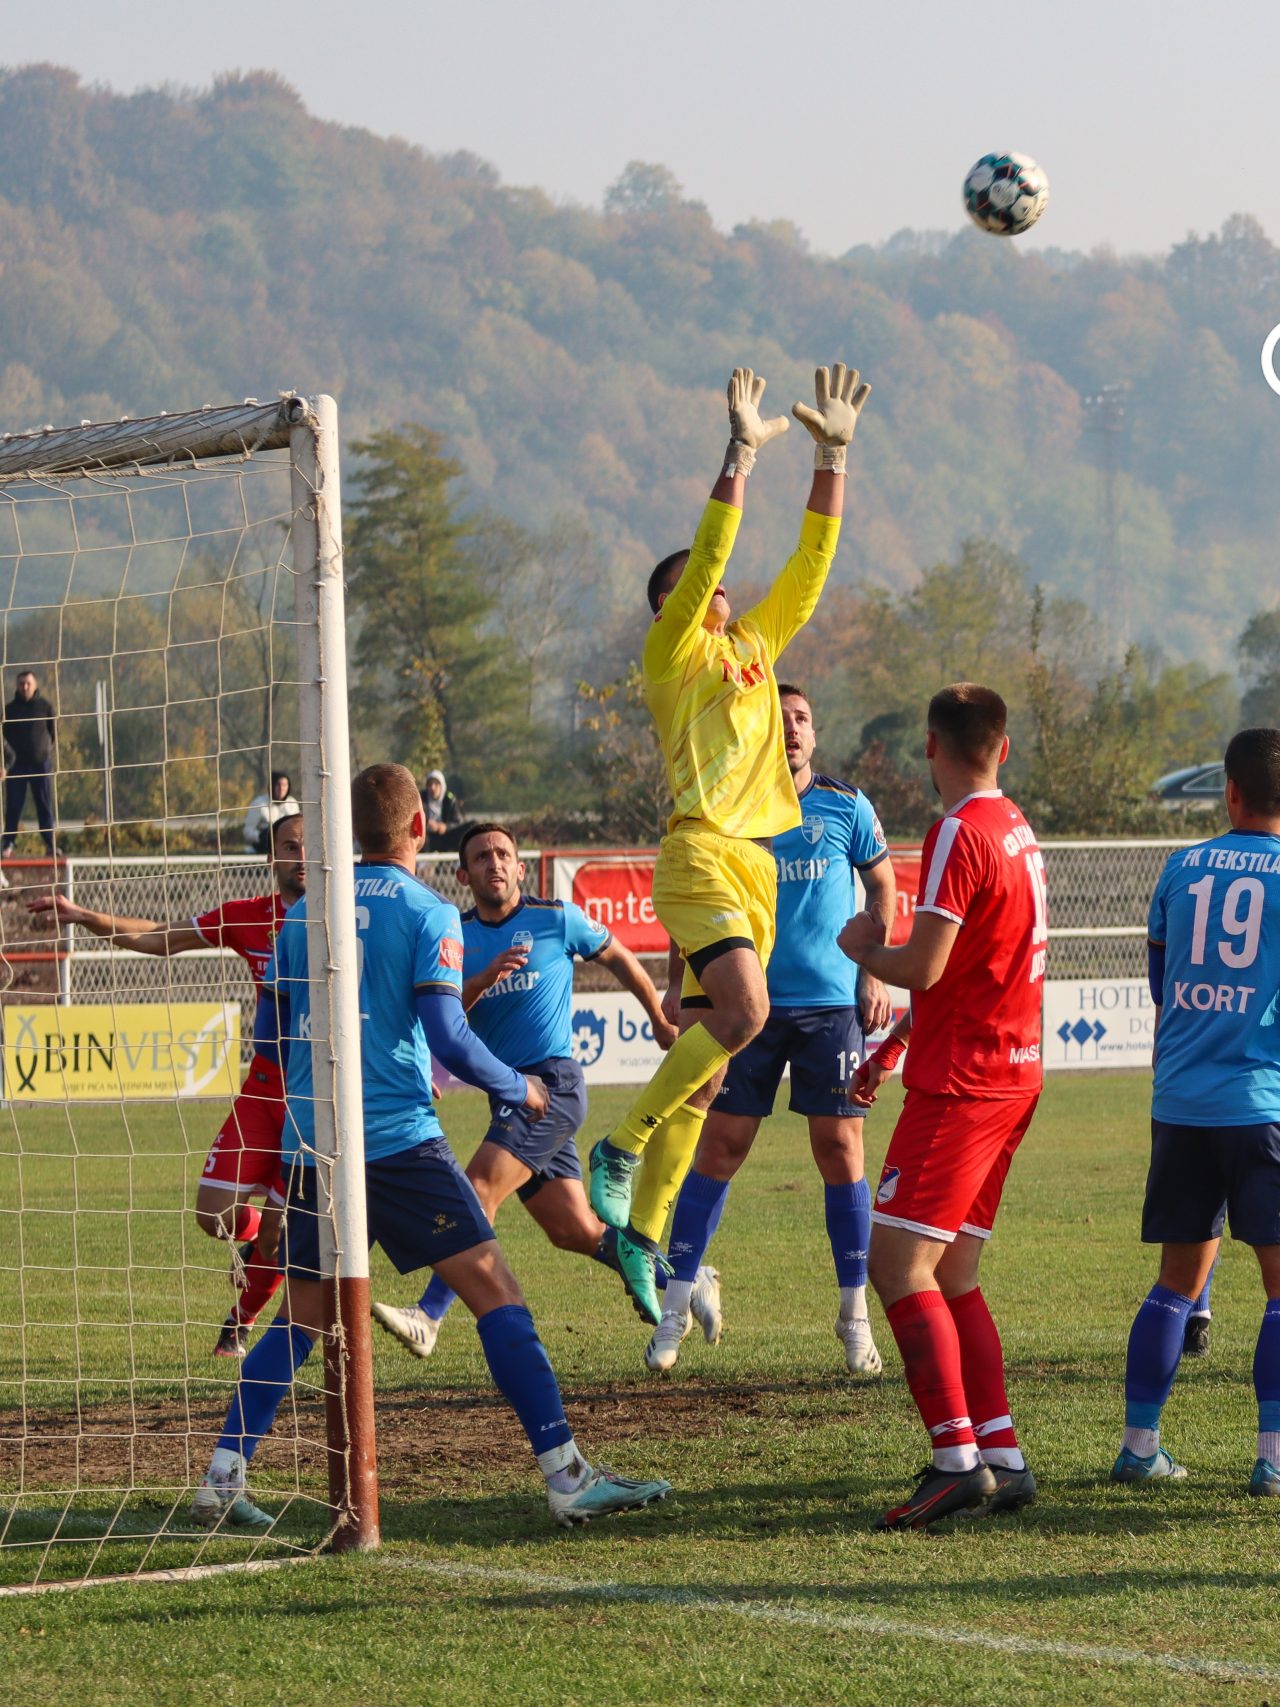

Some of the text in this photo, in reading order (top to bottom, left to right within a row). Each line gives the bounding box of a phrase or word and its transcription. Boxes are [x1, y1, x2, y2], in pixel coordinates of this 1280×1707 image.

[1182, 848, 1205, 868] FK
[354, 878, 405, 899] STILAC
[1187, 874, 1265, 969] 19
[1172, 981, 1256, 1015] KORT
[44, 1030, 228, 1074] BINVEST
[431, 1221, 459, 1236] KELME
